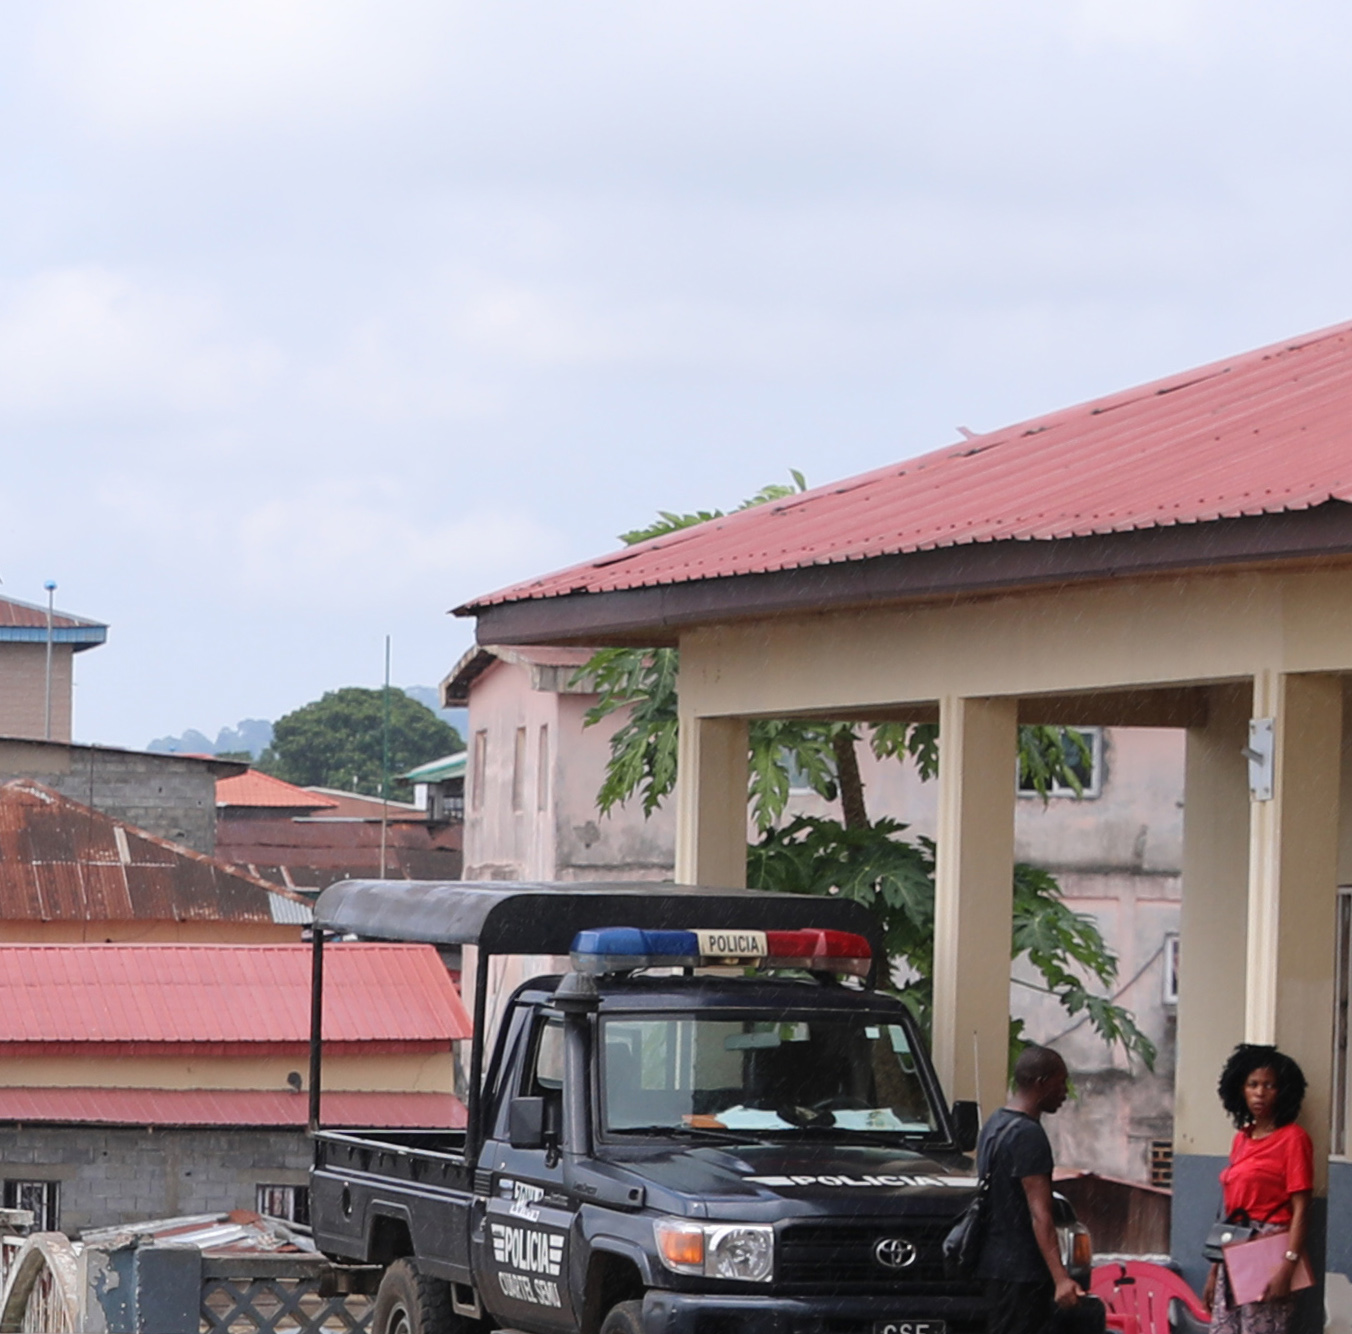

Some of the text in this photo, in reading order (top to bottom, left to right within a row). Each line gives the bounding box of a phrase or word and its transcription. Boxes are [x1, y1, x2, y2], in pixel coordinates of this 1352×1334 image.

[709, 935, 760, 952] POLICIA
[791, 1175, 945, 1187] POLICIA
[505, 1226, 550, 1274] POLICIA
